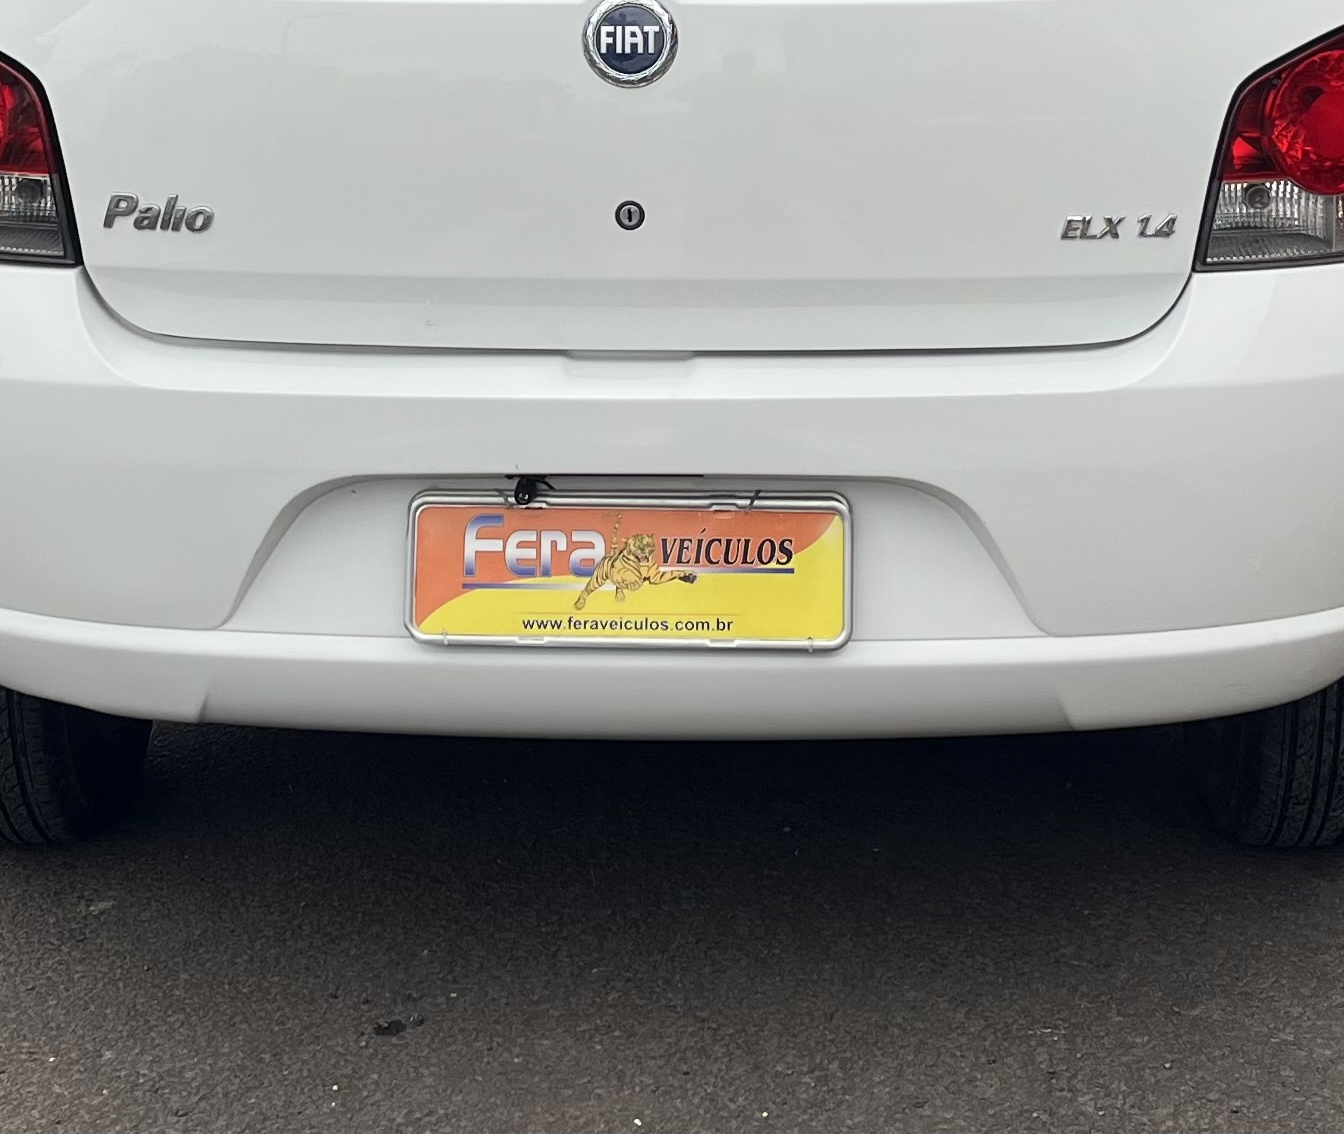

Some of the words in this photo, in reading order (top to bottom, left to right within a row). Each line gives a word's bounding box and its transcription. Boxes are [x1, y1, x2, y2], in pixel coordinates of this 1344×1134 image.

[600, 25, 660, 54] FIAT
[103, 191, 215, 233] Palio
[1060, 214, 1126, 240] ELX
[659, 527, 794, 567] VEÍCULOS
[521, 615, 734, 633] www.feraveiculos.com.br
